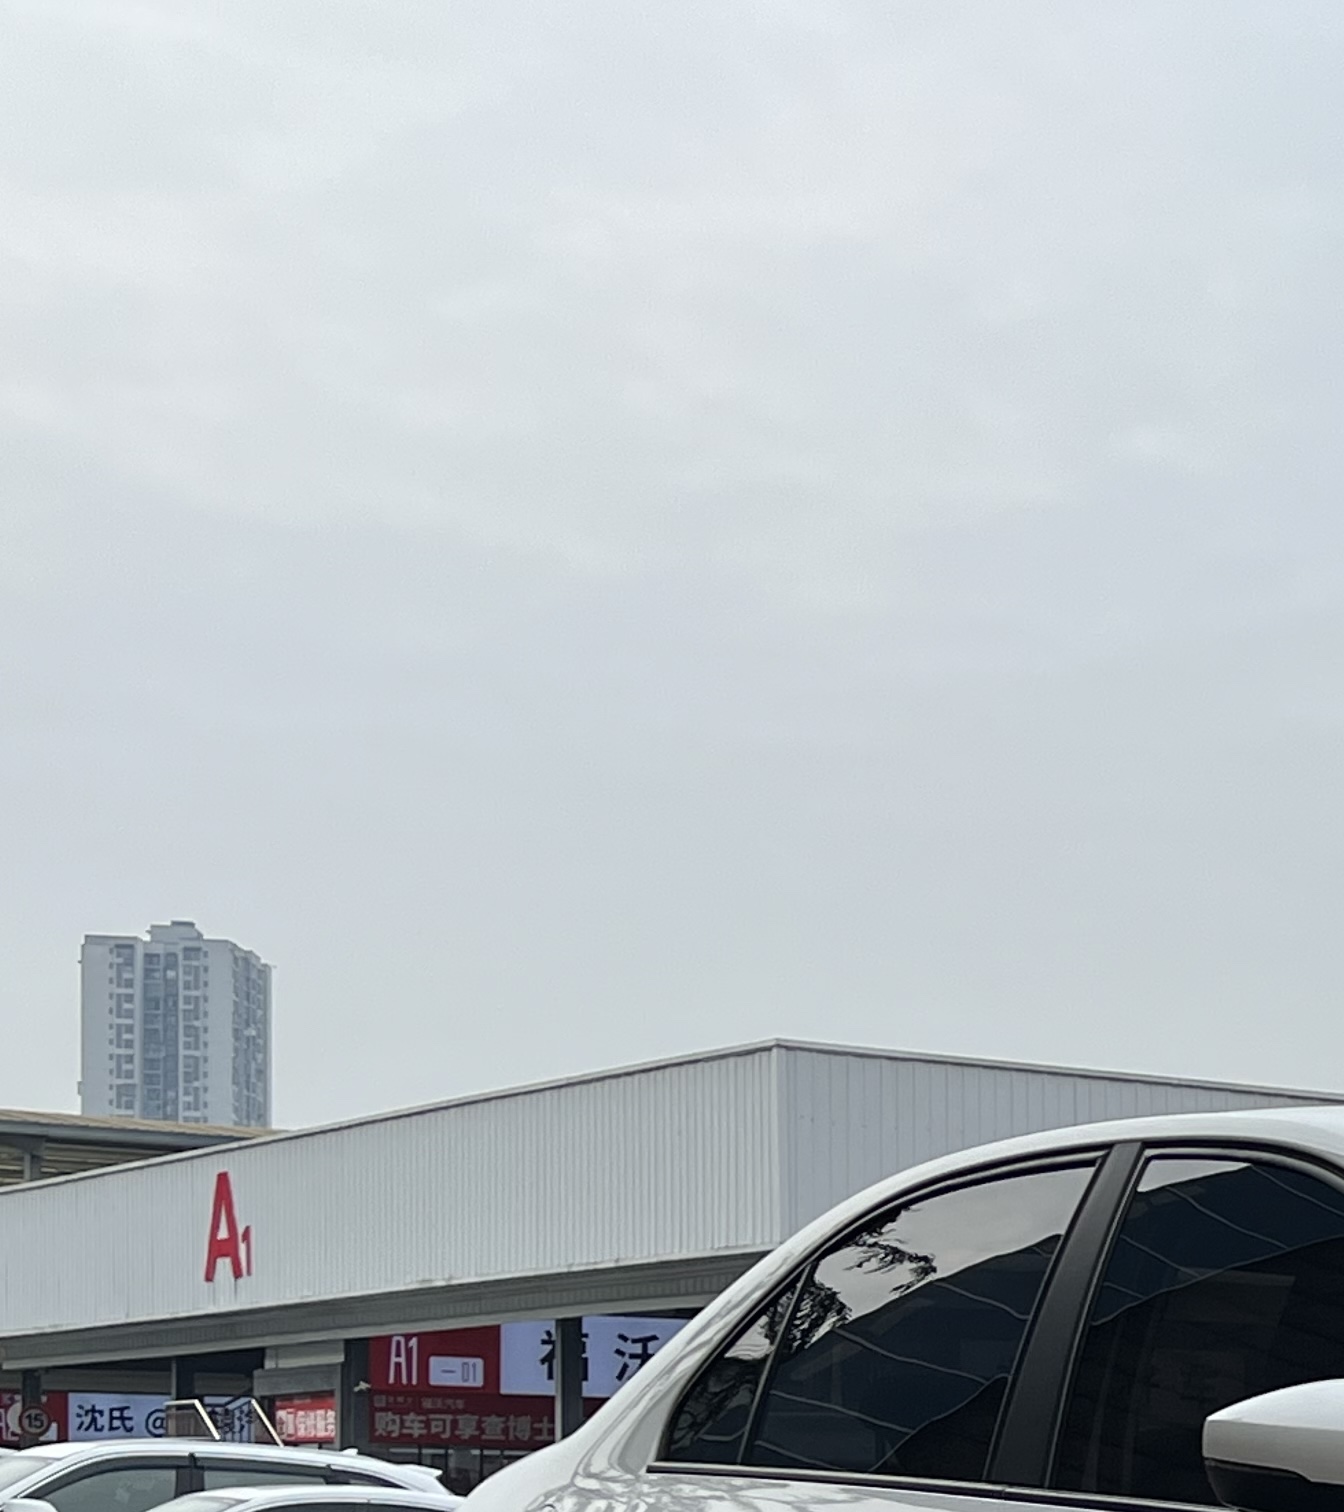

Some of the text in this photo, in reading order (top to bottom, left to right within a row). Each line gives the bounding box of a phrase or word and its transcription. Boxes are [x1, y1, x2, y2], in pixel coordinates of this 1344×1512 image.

[205, 1171, 251, 1282] A1
[388, 1335, 418, 1386] A1
[25, 1412, 44, 1429] 15
[76, 1404, 134, 1433] 沈氏
[374, 1411, 554, 1441] 购车可享查博士
